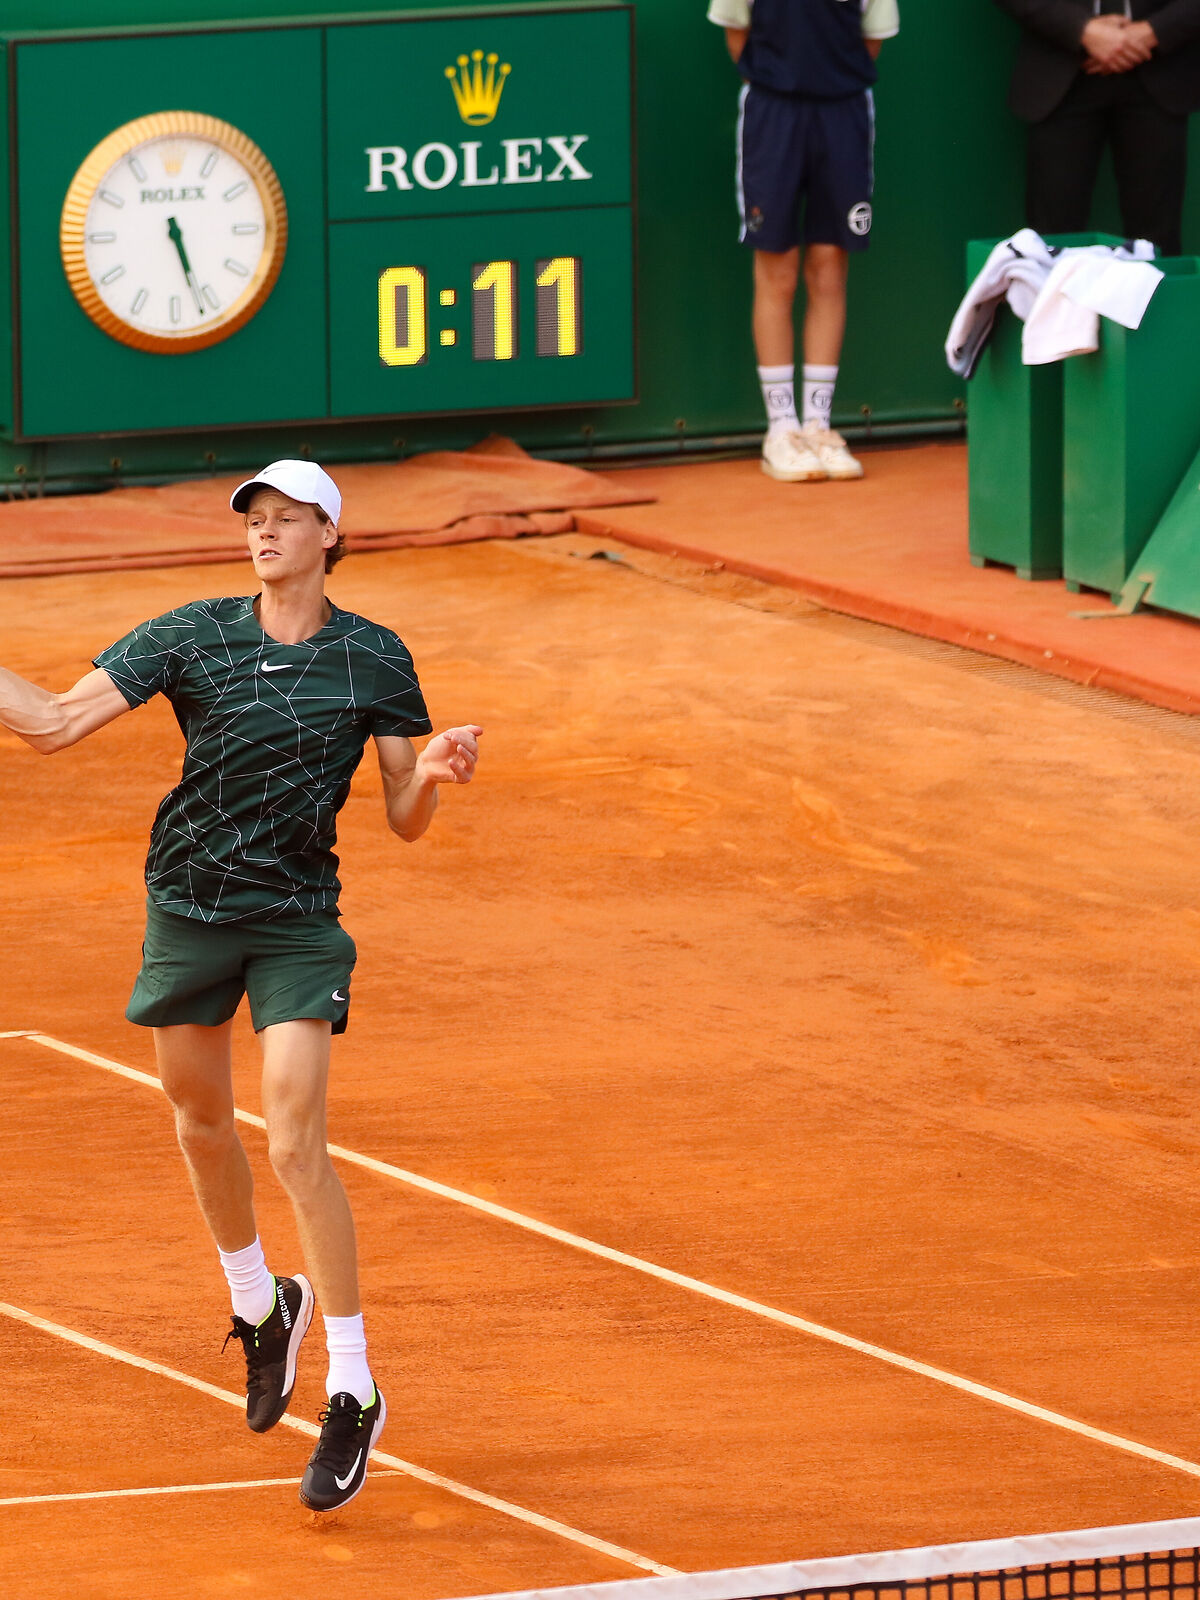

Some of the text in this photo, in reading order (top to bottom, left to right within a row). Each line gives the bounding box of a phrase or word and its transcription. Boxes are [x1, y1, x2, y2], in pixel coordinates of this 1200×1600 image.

[364, 134, 593, 193] ROLEX
[140, 186, 206, 204] ROLEX
[378, 257, 577, 367] 0:11
[275, 1284, 292, 1330] NIKECOURT
